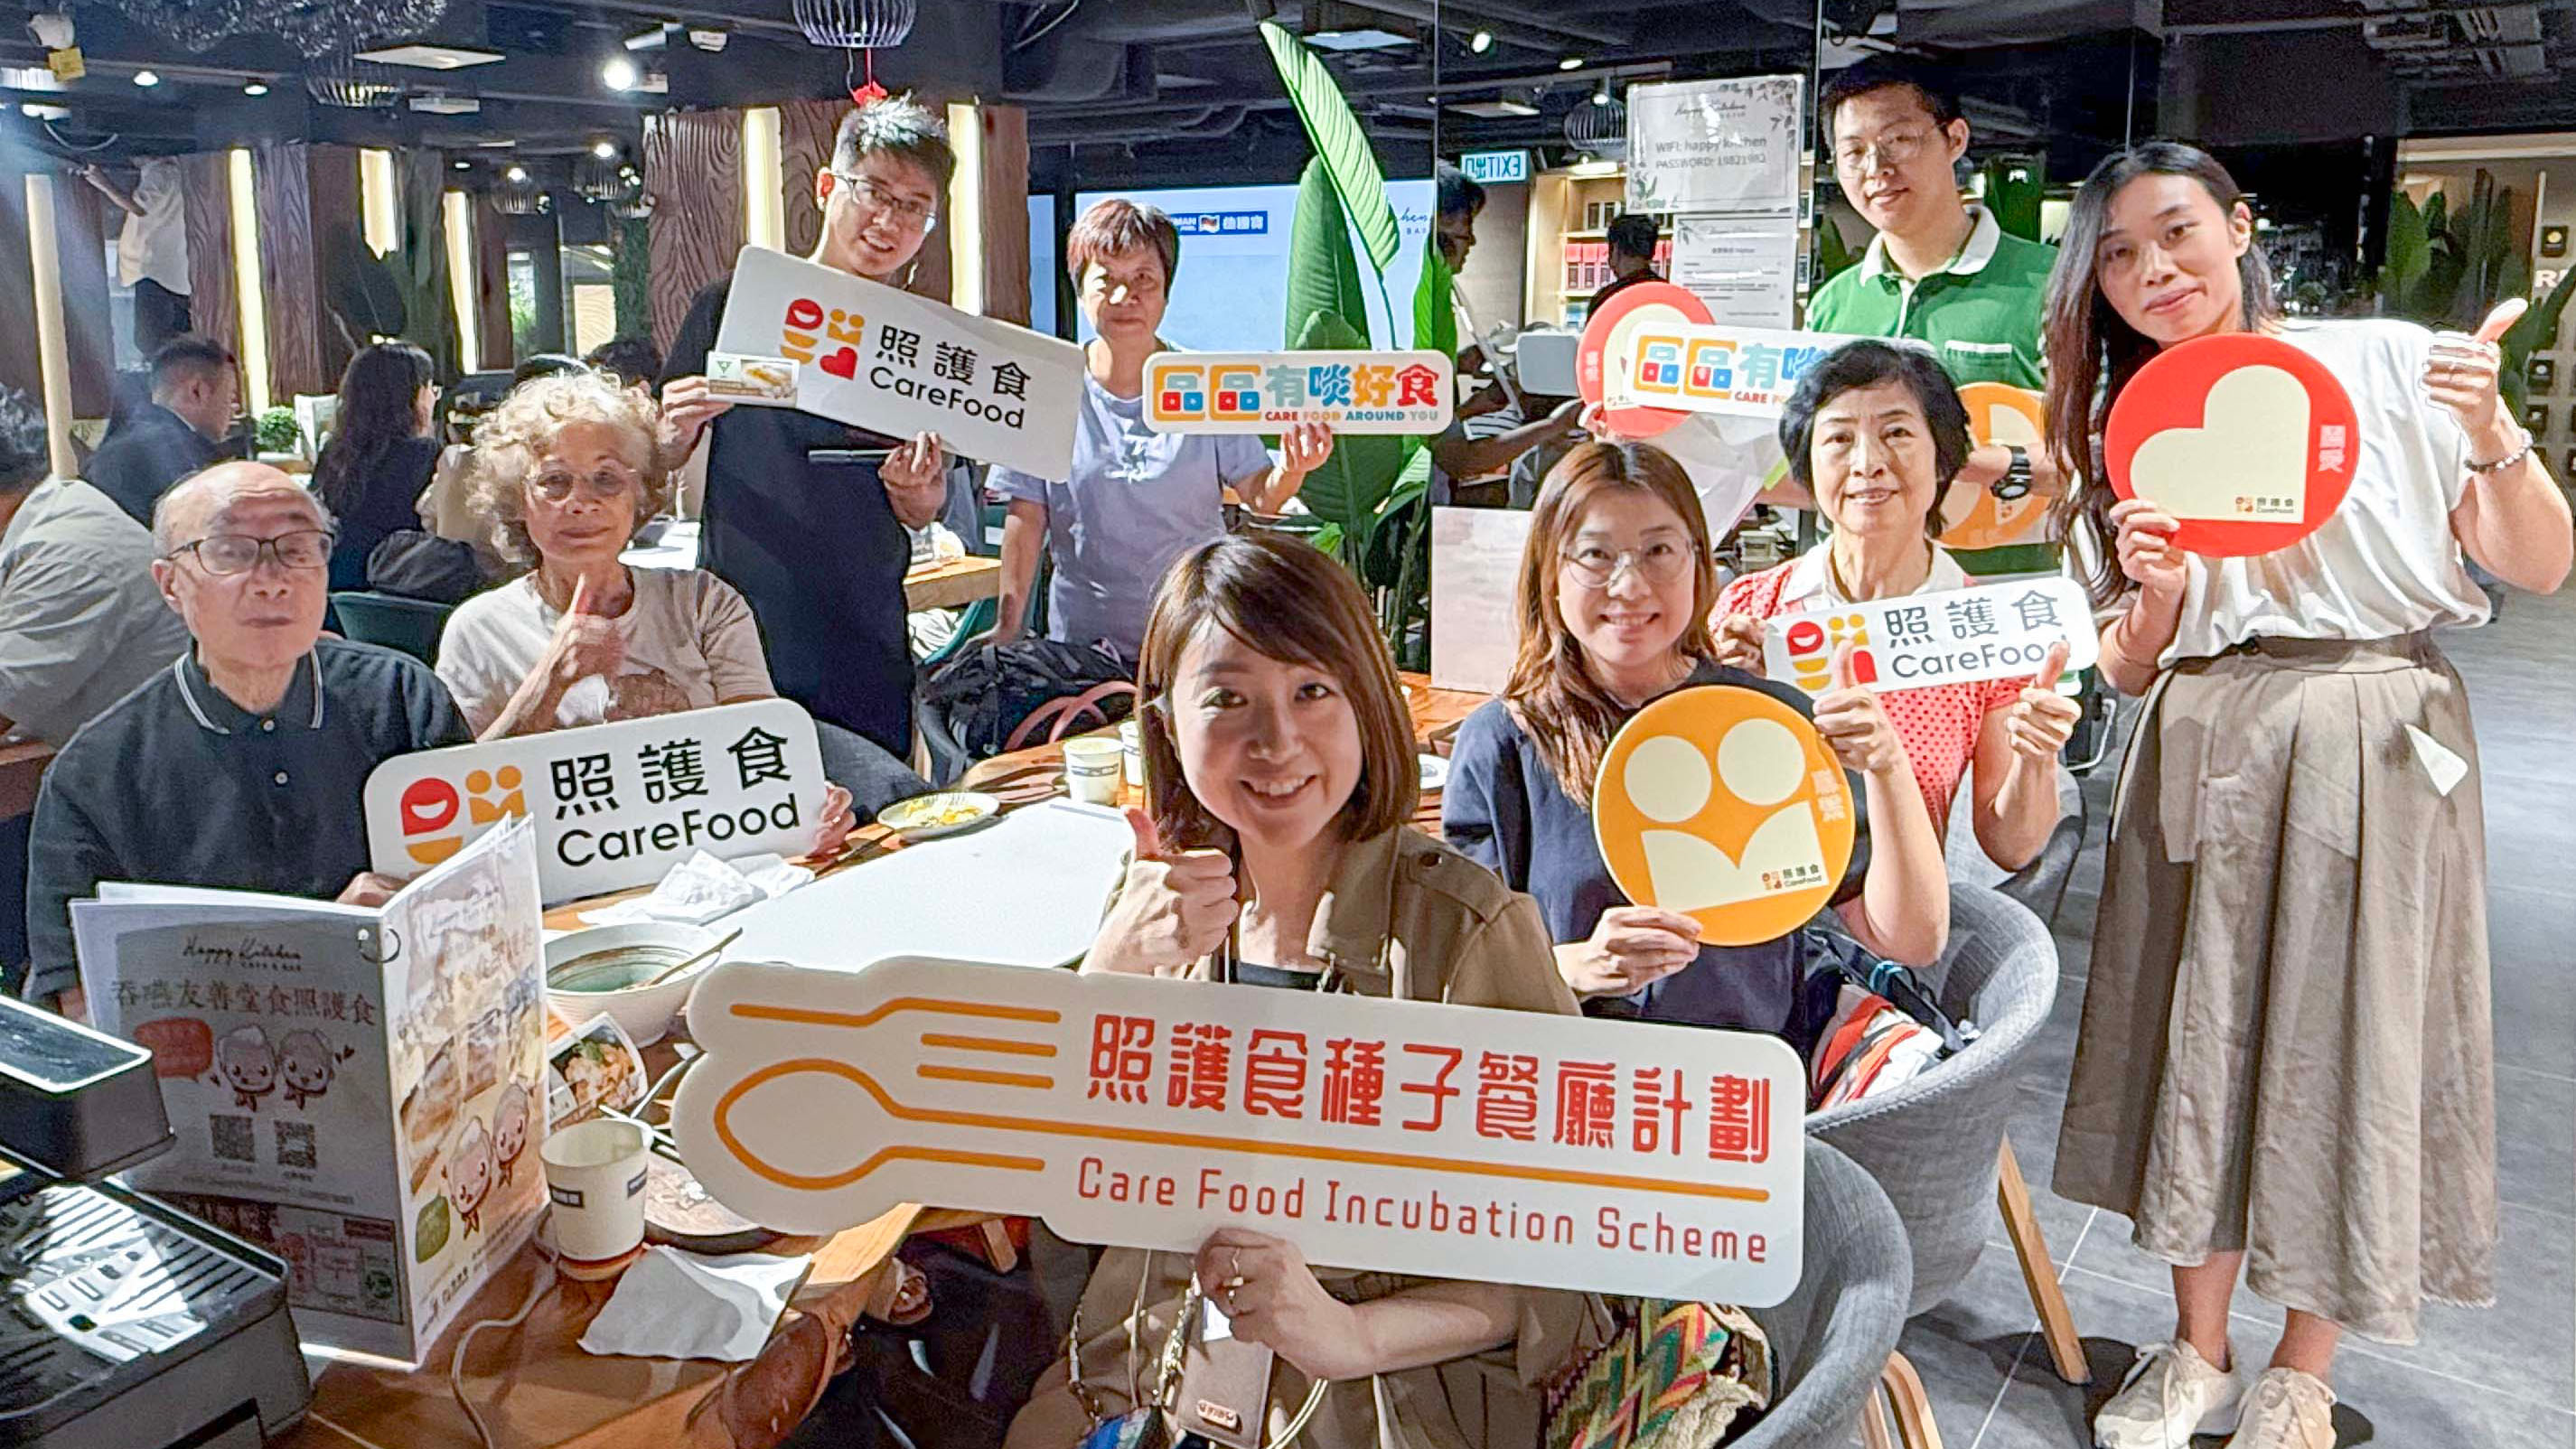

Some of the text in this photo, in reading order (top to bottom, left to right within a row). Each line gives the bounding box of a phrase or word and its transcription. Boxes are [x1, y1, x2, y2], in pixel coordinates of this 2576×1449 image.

[869, 365, 1026, 430] CareFood
[875, 323, 1032, 402] 照護食
[1734, 390, 1768, 404] CARE
[1264, 411, 1439, 422] CARE FOOD AROUND YOU
[1885, 589, 2063, 649] 照護食
[549, 725, 792, 820] 照護食
[557, 793, 801, 866] CareFood
[1087, 1014, 1771, 1164] 照護食種子餐廳計劃
[1078, 1156, 1766, 1263] Care Food Incubation Scheme
